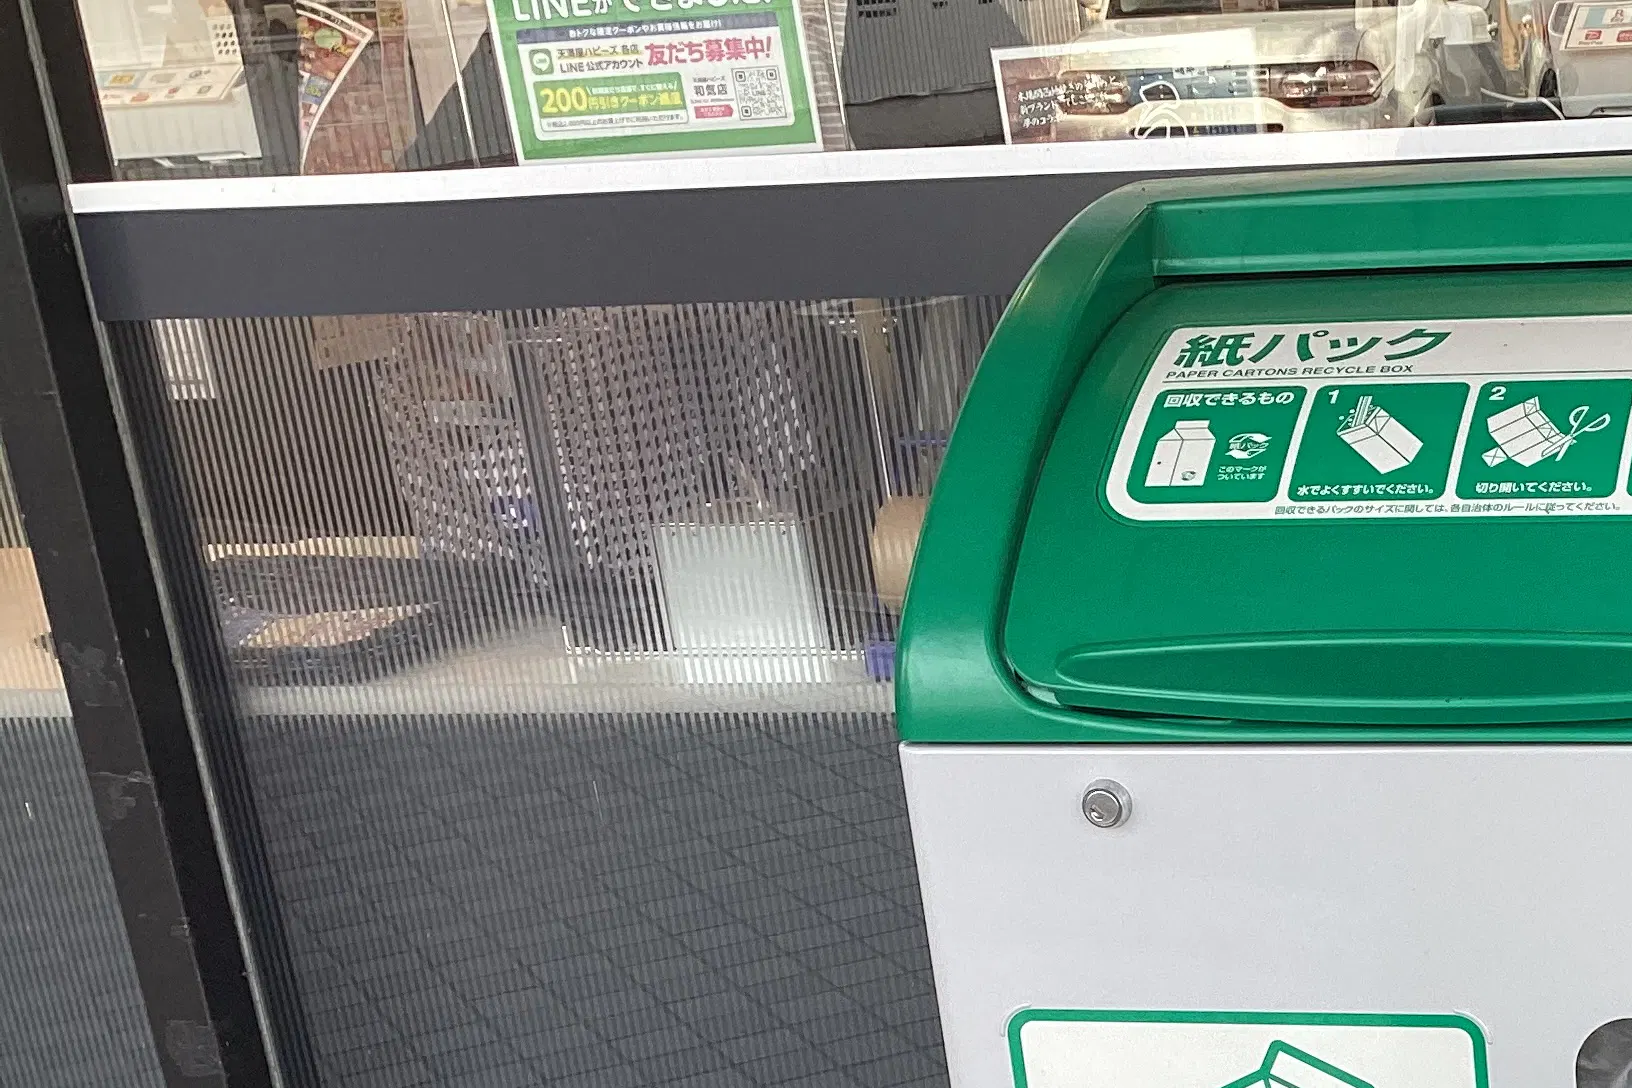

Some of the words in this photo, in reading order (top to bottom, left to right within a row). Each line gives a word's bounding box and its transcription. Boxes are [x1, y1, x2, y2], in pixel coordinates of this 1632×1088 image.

[644, 36, 772, 66] 友だち募集中!
[560, 62, 584, 73] LINE
[1173, 328, 1452, 368] 紙パック
[1165, 369, 1218, 379] PAPER
[1222, 367, 1297, 378] CARTONS
[1302, 365, 1375, 375] RECYCLE
[1380, 364, 1414, 373] BOX
[1163, 391, 1294, 408] 回収できるもの
[1328, 389, 1340, 404] 1
[1488, 386, 1506, 401] 2
[1297, 482, 1434, 496] 水でよくすすいでください。
[1475, 480, 1593, 494] 切り開いてください。
